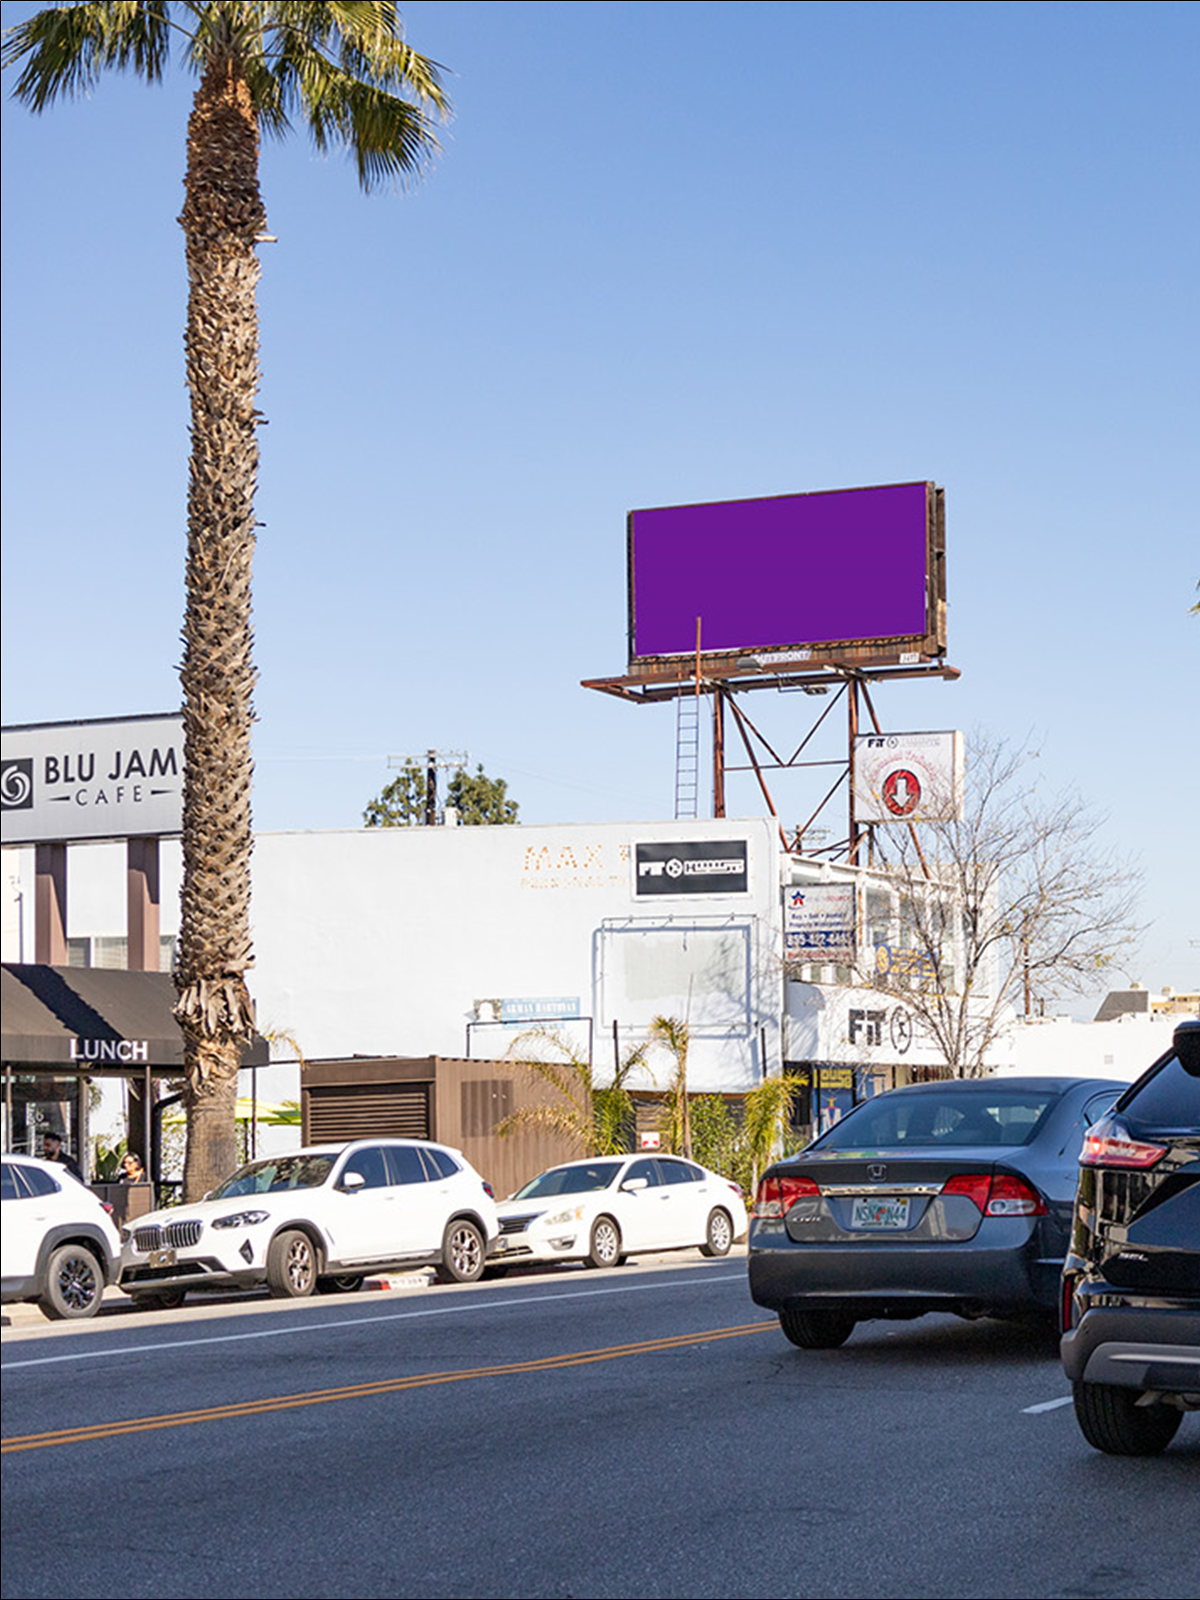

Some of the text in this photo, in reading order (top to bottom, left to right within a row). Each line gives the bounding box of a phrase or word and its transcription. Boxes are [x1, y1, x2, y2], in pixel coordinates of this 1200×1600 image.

[45, 747, 177, 784] BLU JAM
[76, 785, 142, 806] CAFE
[69, 1038, 148, 1061] LUNCH
